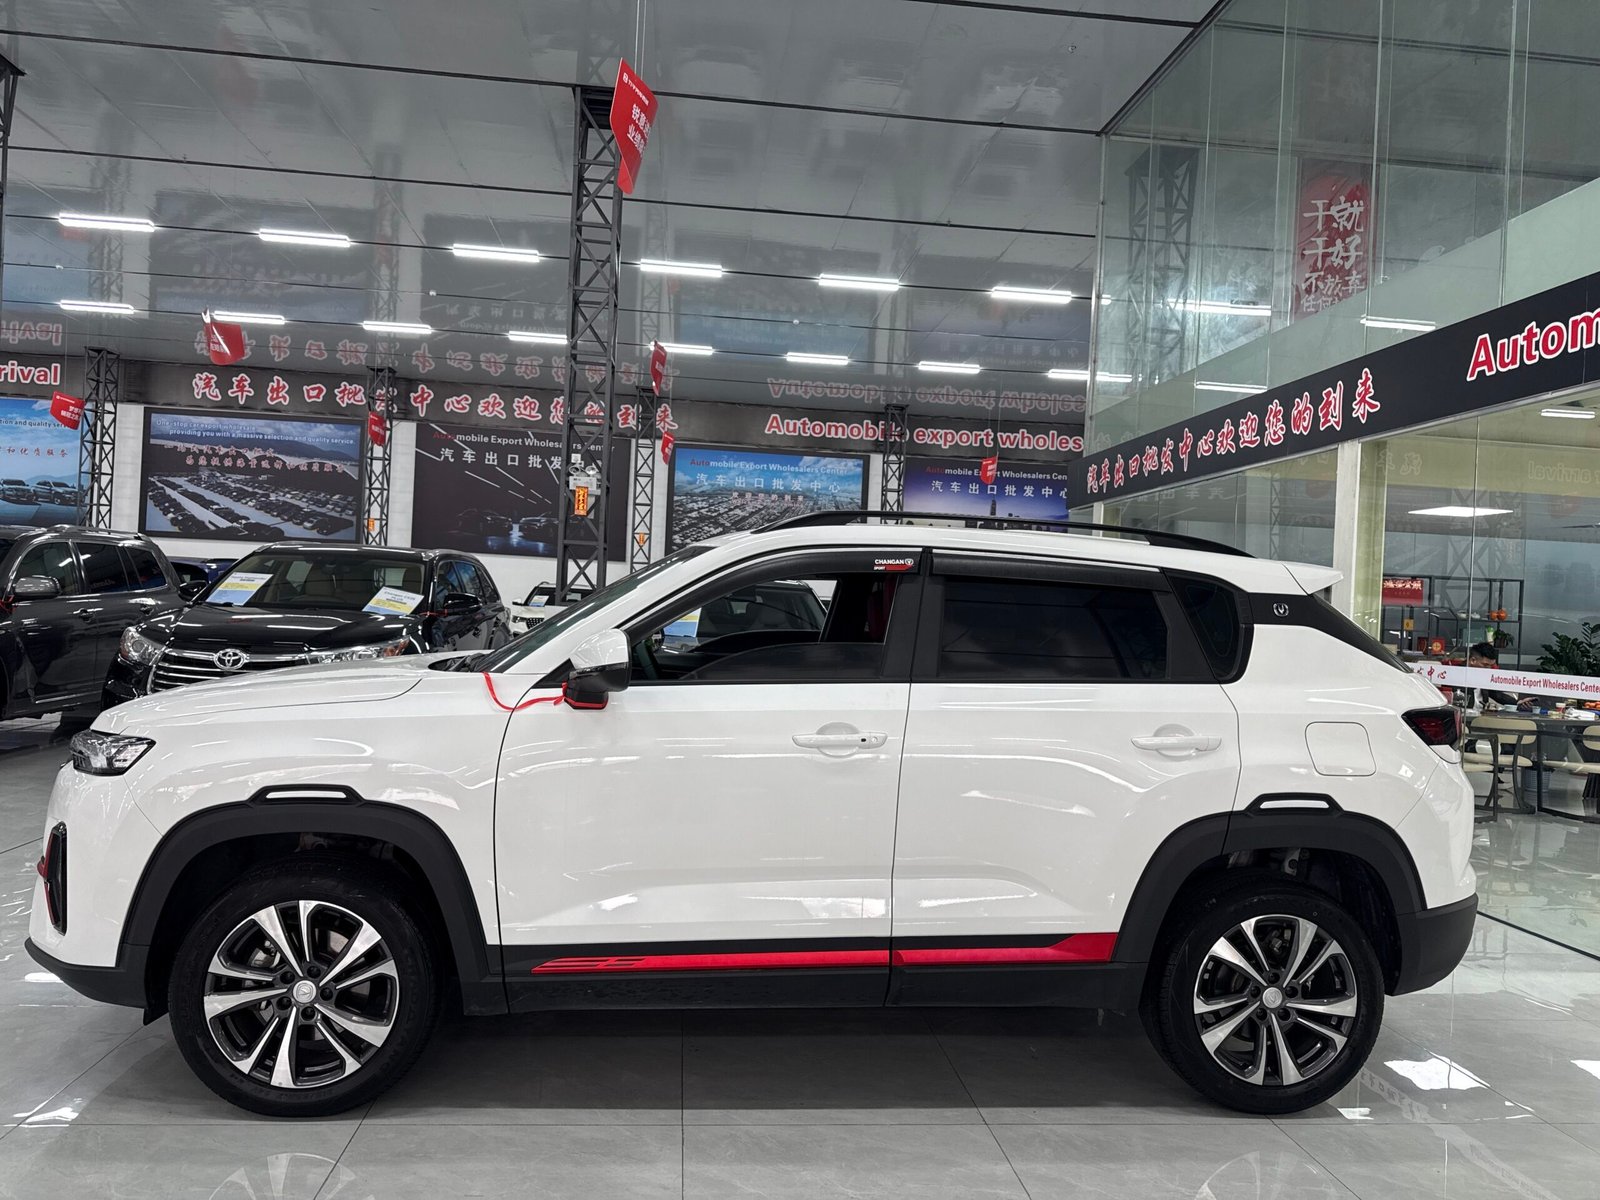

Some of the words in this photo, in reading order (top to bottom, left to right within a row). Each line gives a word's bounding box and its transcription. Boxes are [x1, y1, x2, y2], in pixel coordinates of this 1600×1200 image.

[1303, 234, 1364, 269] 干好
[1466, 308, 1600, 381] Autom
[169, 429, 201, 437] providing
[263, 433, 294, 441] selection
[913, 427, 994, 449] export
[997, 429, 1084, 452] wholes
[1087, 367, 1381, 494] 汽车出口批发中心欢迎您的到来
[491, 436, 523, 447] Export
[524, 438, 582, 450] Wholesars
[690, 458, 737, 469] Automobile
[740, 462, 768, 471] Export
[769, 463, 819, 474] Wholesalers
[820, 466, 849, 476] Center
[925, 466, 973, 476] Automobile
[1002, 470, 1051, 480] Wholesalers
[696, 472, 841, 494] 汽车出口批发中心
[1489, 674, 1521, 686] Automobile
[1522, 677, 1542, 688] Export
[1542, 678, 1580, 691] Wholesalers
